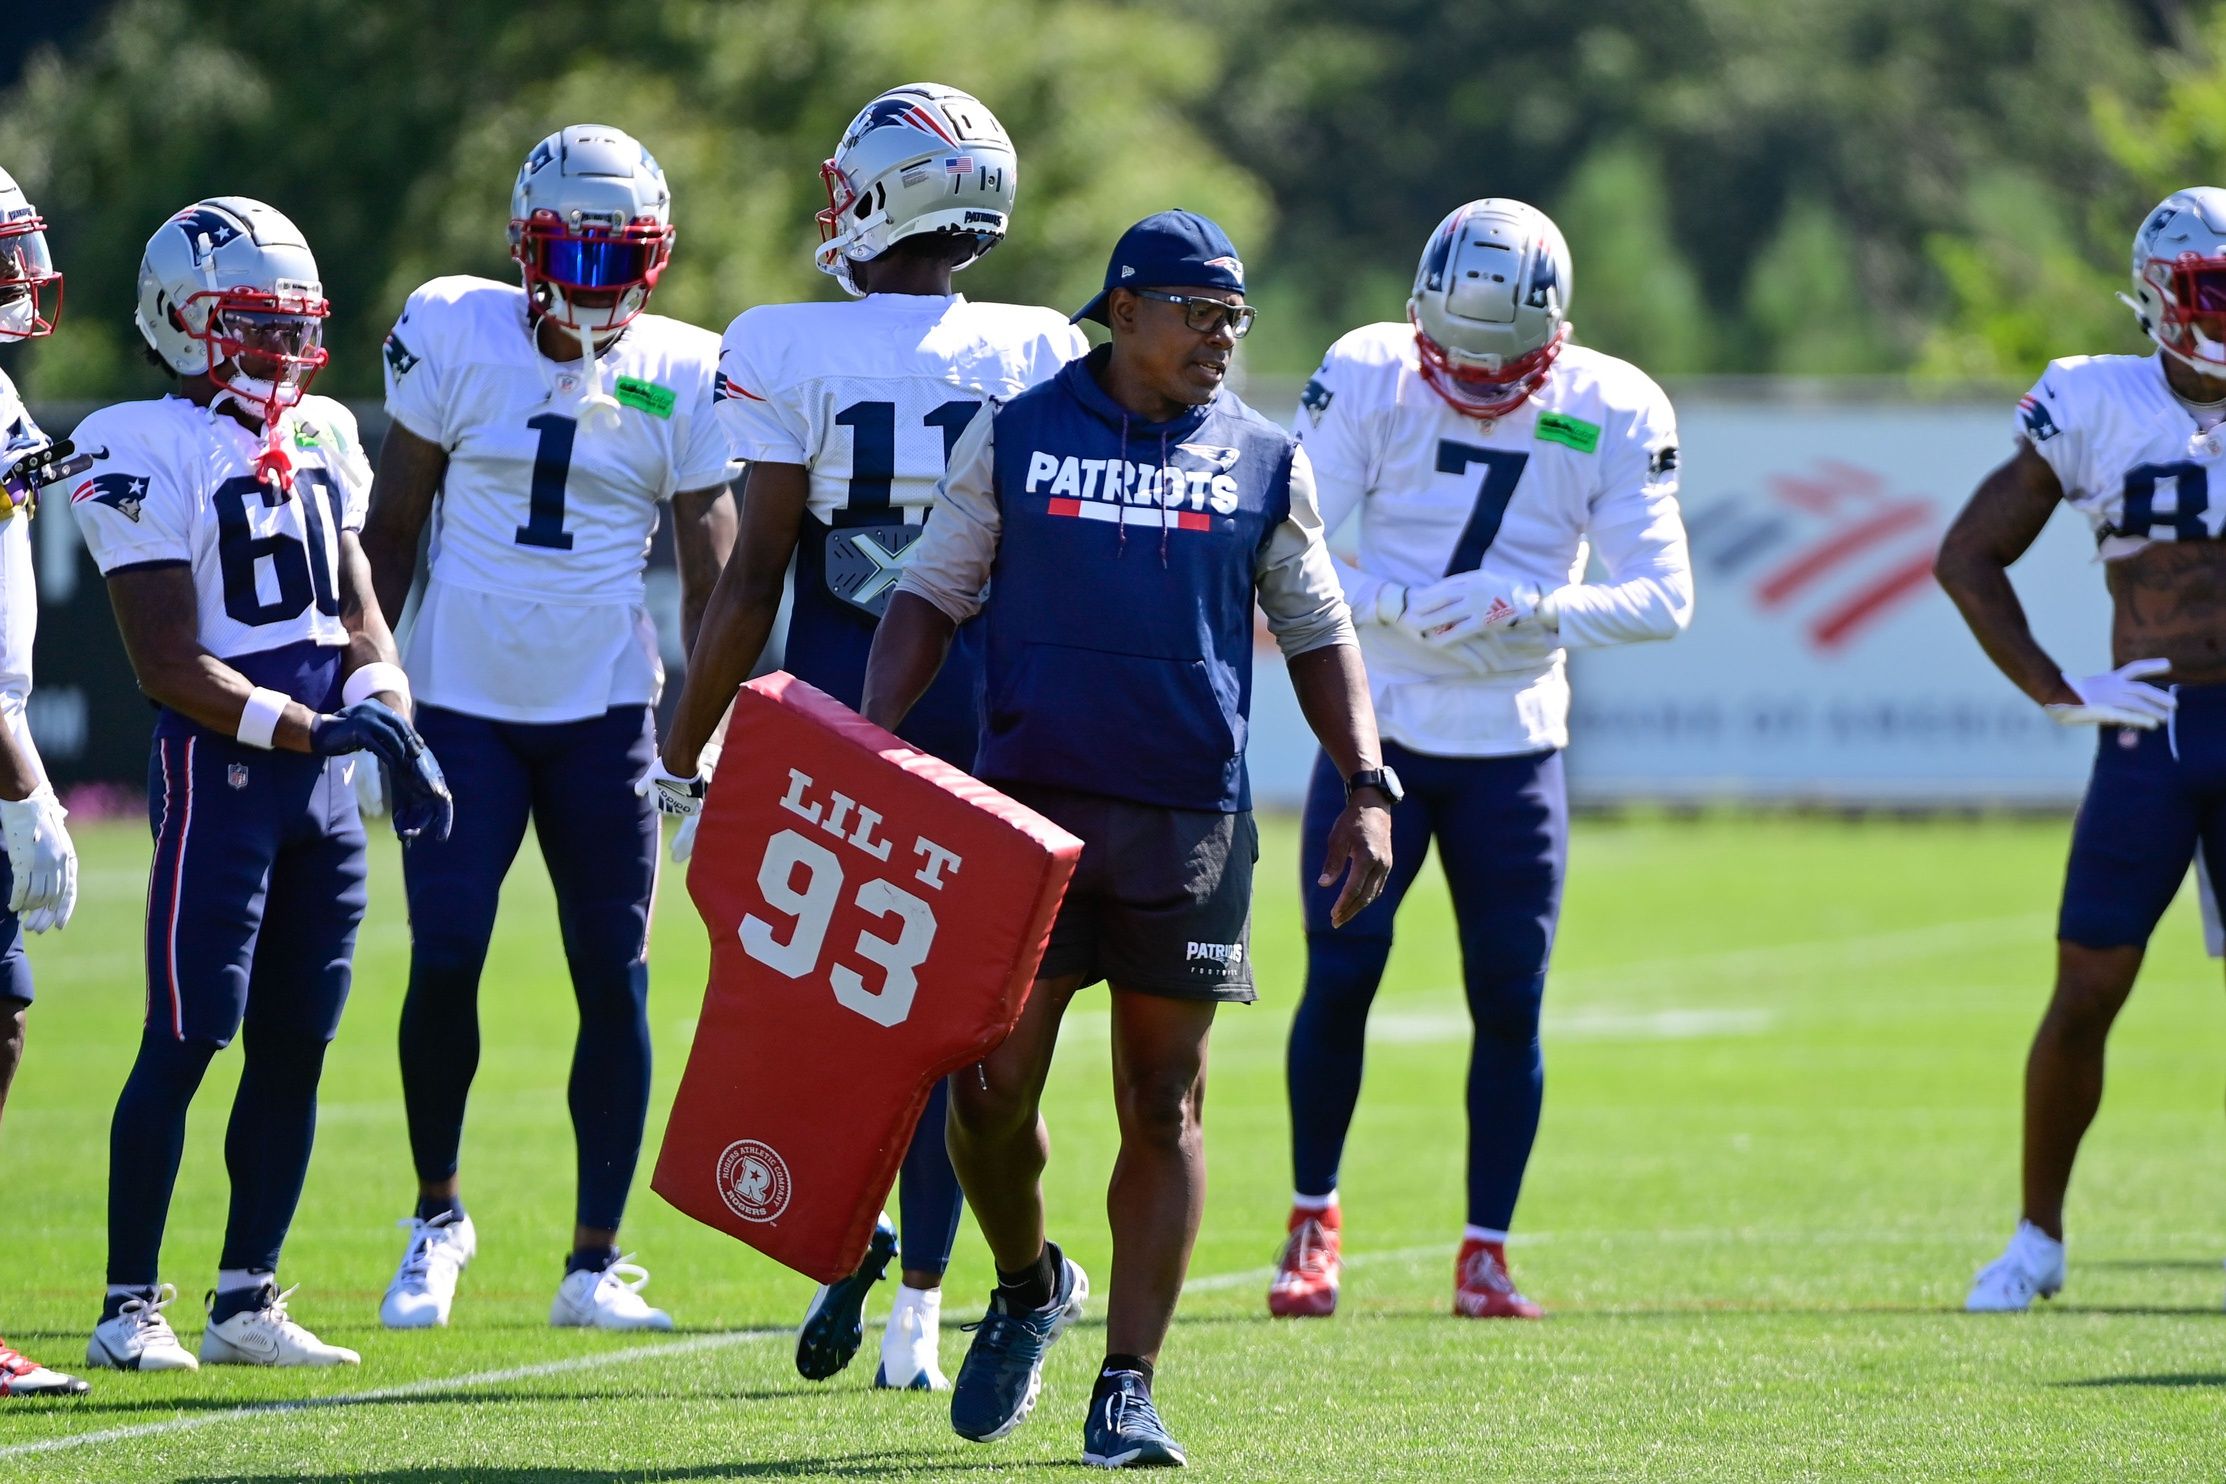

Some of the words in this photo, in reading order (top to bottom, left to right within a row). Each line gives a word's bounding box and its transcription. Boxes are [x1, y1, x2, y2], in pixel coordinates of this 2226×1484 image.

[515, 412, 577, 550] 1
[1025, 450, 1238, 515] PATRIOTS
[1435, 438, 1530, 578] 7
[213, 467, 343, 627] 60
[779, 768, 892, 862] LIL
[913, 835, 962, 890] T
[738, 828, 938, 1028] 93
[722, 1150, 740, 1179] ROGERS
[740, 1146, 777, 1166] ATHLETIC
[773, 1166, 786, 1207] COMPANY
[727, 1190, 767, 1216] ROGERS
